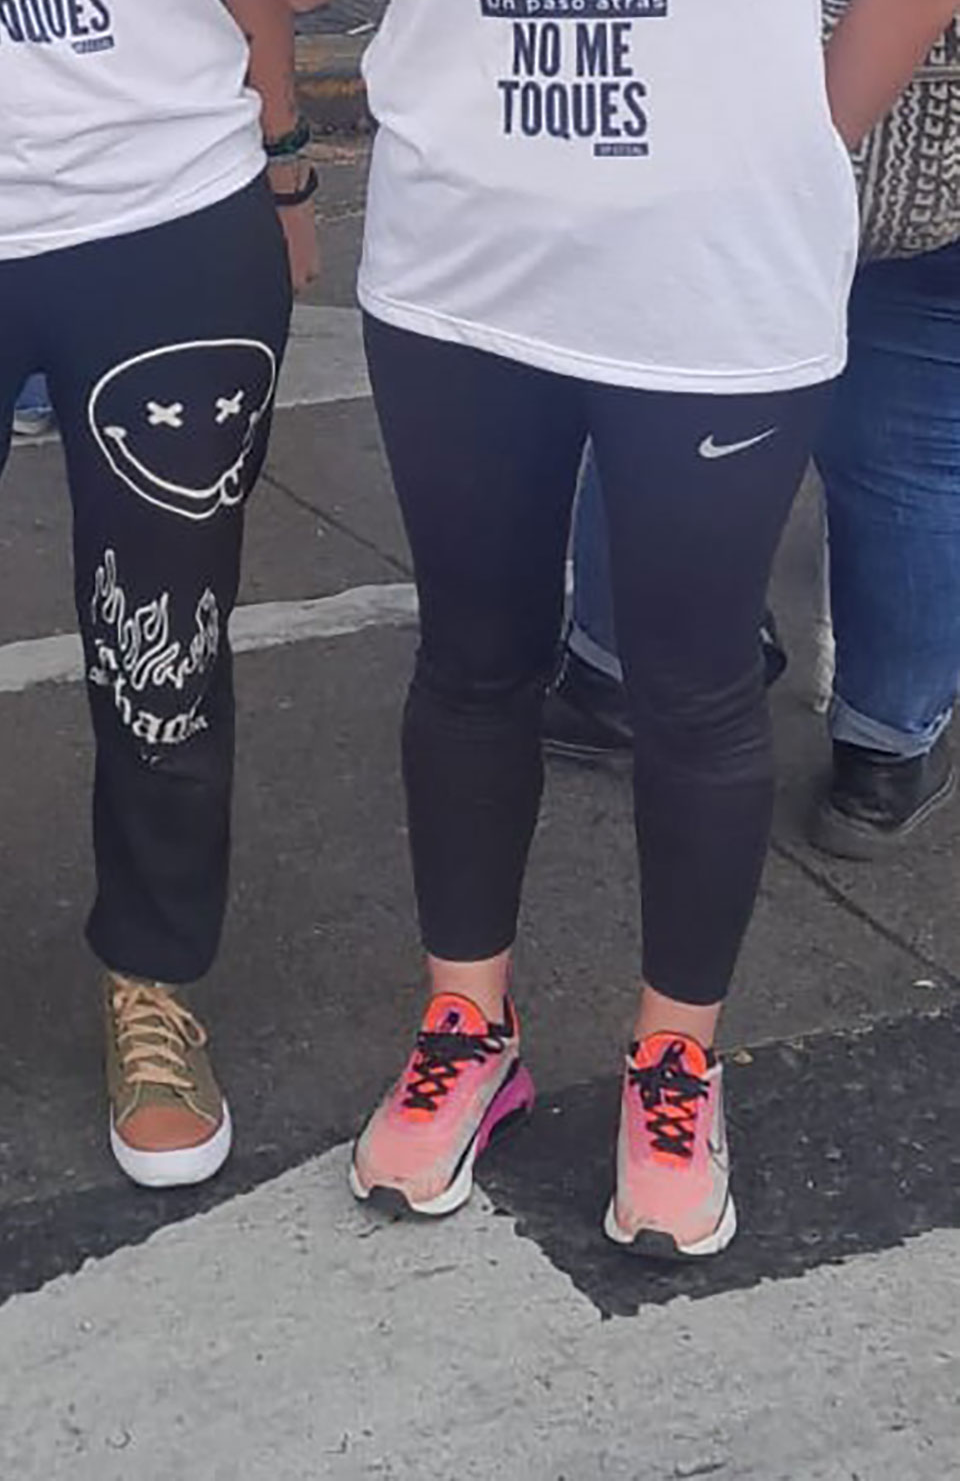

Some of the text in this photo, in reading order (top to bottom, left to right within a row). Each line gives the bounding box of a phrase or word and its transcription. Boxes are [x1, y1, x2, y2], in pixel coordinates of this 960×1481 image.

[513, 21, 633, 77] NO ME
[498, 80, 647, 140] TOQUES
